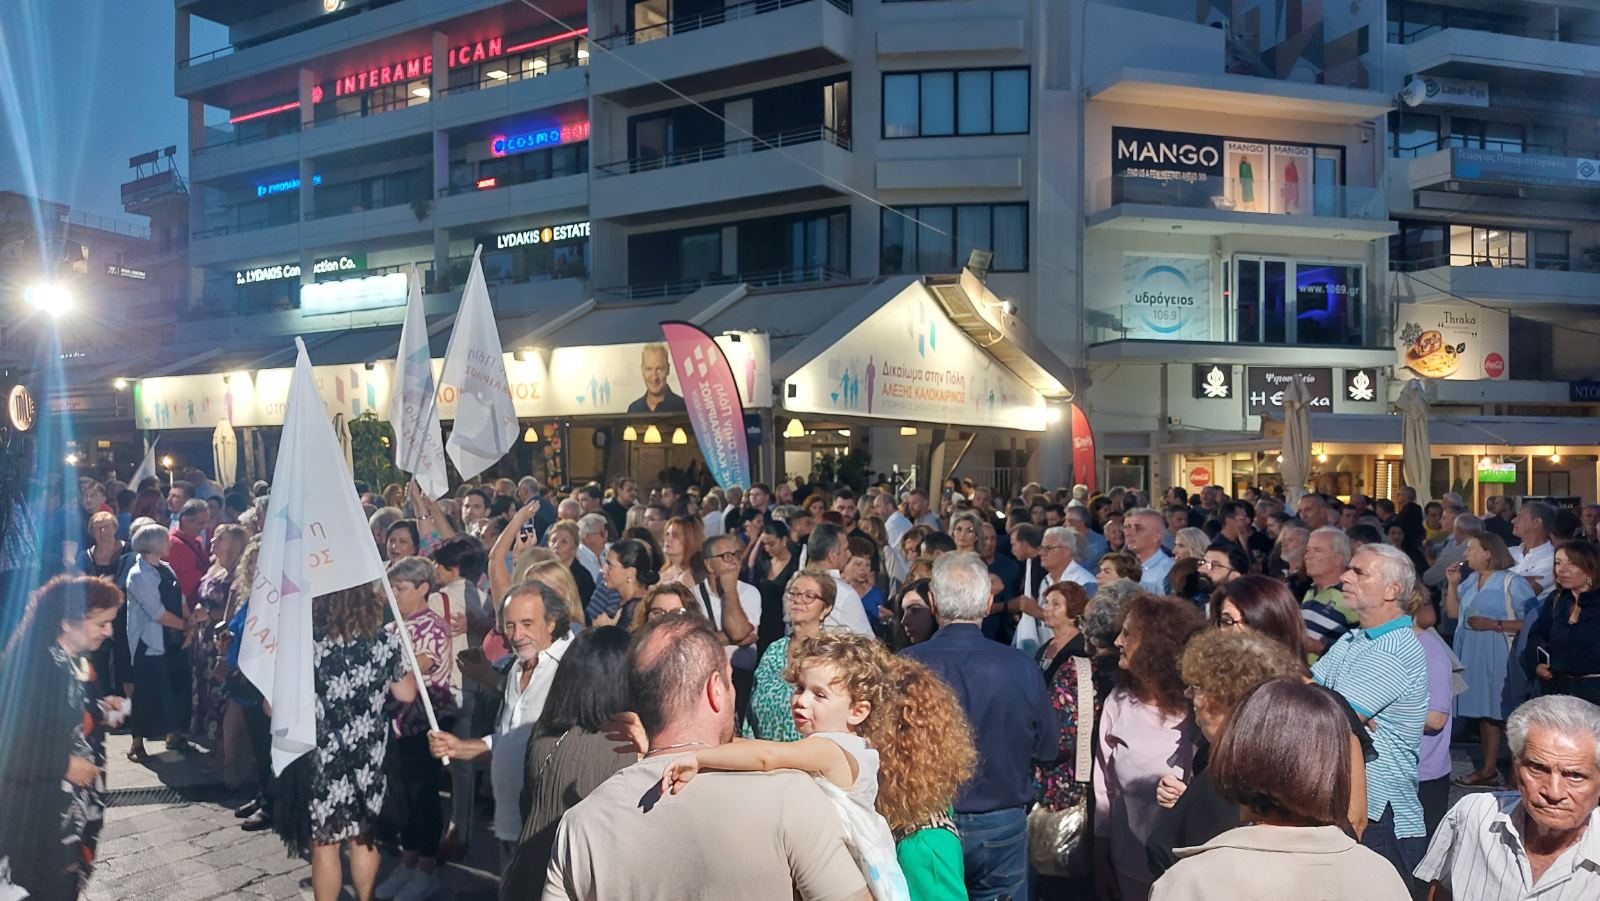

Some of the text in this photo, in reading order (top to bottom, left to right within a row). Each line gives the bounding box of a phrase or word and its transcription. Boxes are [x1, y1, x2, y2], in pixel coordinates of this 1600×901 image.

[335, 37, 503, 96] INTERAMEICAN
[1118, 139, 1219, 167] MANGO
[1228, 143, 1264, 153] MANGO
[1273, 146, 1309, 155] MANGO
[498, 222, 591, 249] LYDAKIS ESTATE
[246, 265, 283, 283] LYDAKIS
[340, 256, 356, 270] Co.
[1299, 284, 1360, 297] www.1069.gr
[1135, 291, 1194, 307] υδρόγειος
[1444, 311, 1476, 325] Thraka
[882, 361, 965, 389] Δικαίωμα στην Πόλη
[882, 383, 913, 399] ΑΛΕΞΗΣ
